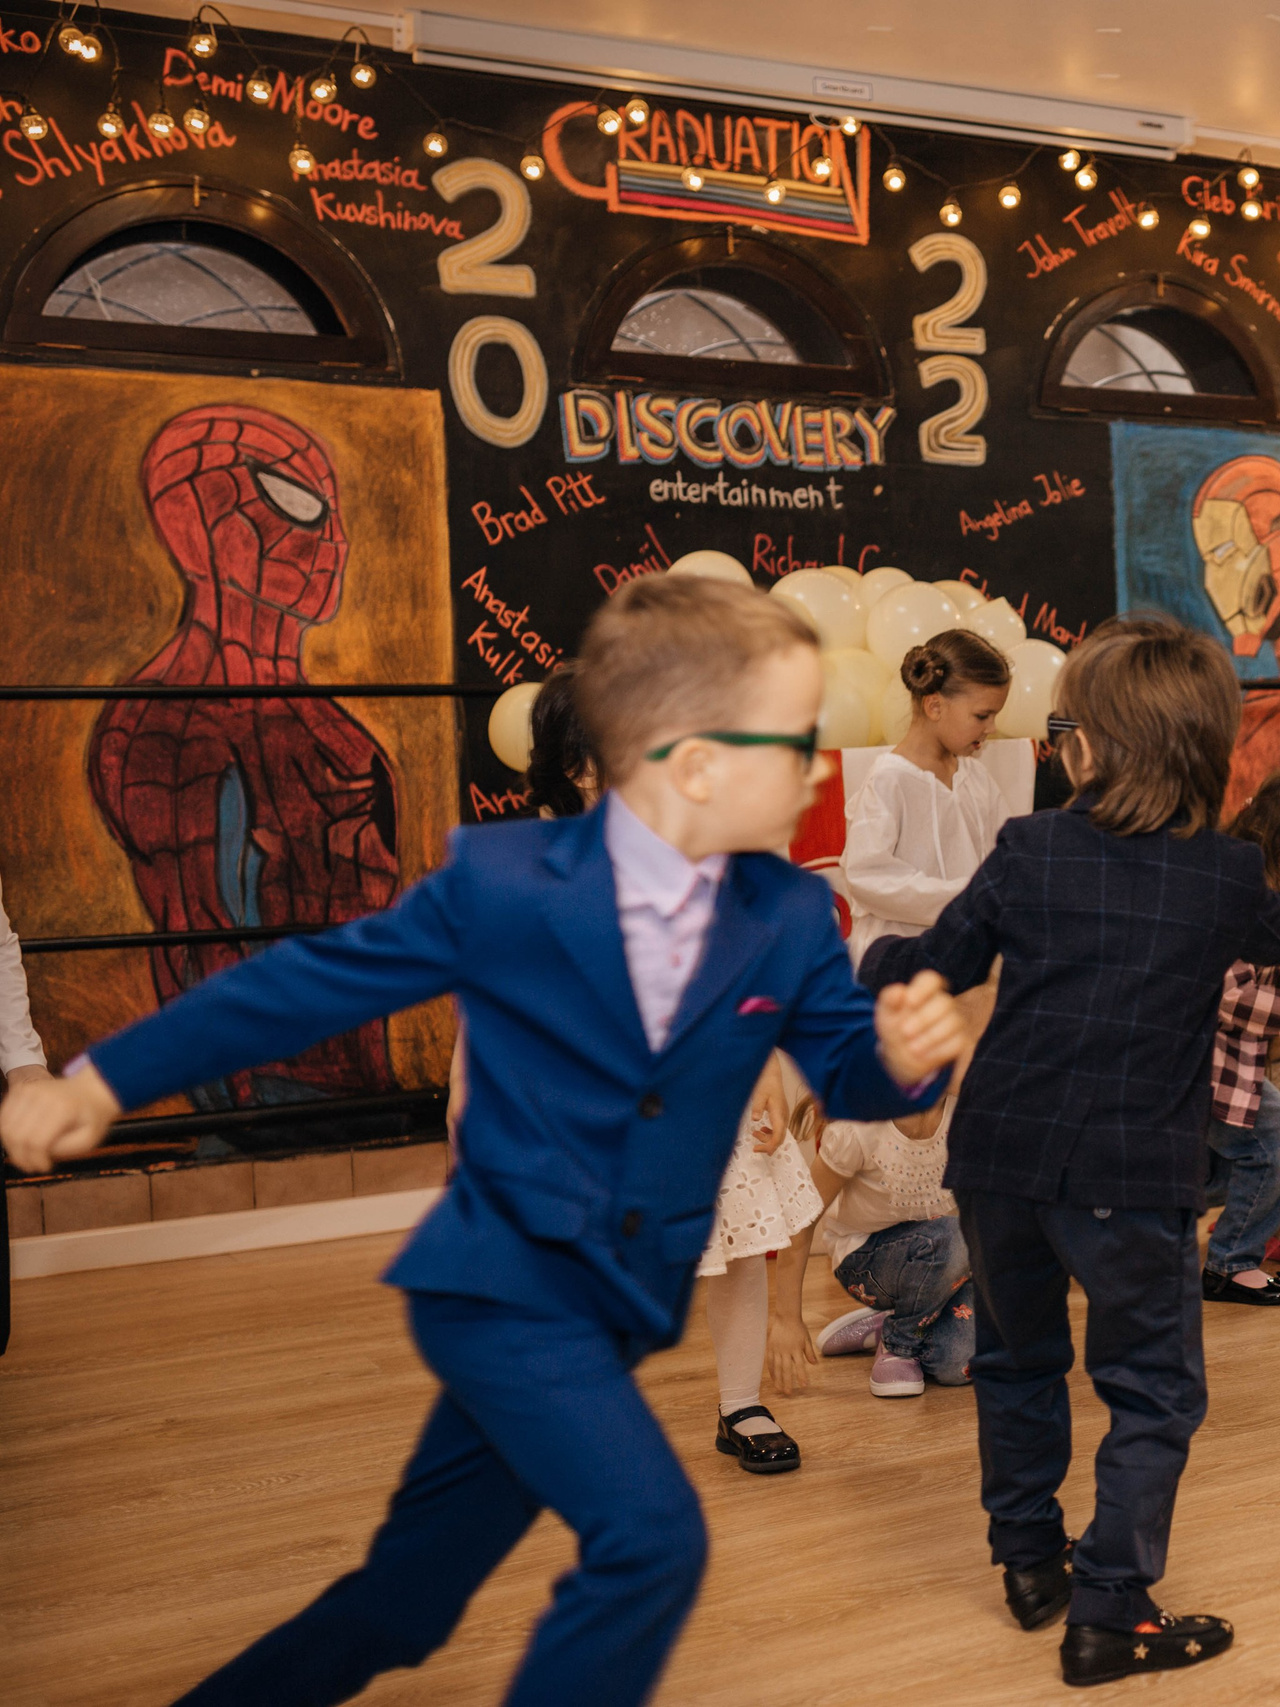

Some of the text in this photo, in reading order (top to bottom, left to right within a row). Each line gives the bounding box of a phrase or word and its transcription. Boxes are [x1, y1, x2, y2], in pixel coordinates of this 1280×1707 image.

[163, 48, 379, 140] Demi Moore
[292, 149, 428, 191] nastasia
[542, 100, 871, 246] GRADUATION
[1062, 187, 1148, 247] Travolt
[559, 389, 897, 472] DISCOVERY
[471, 470, 607, 546] Brad Pitt
[649, 470, 845, 512] entertainment
[959, 470, 1086, 542] Angelina Jolie
